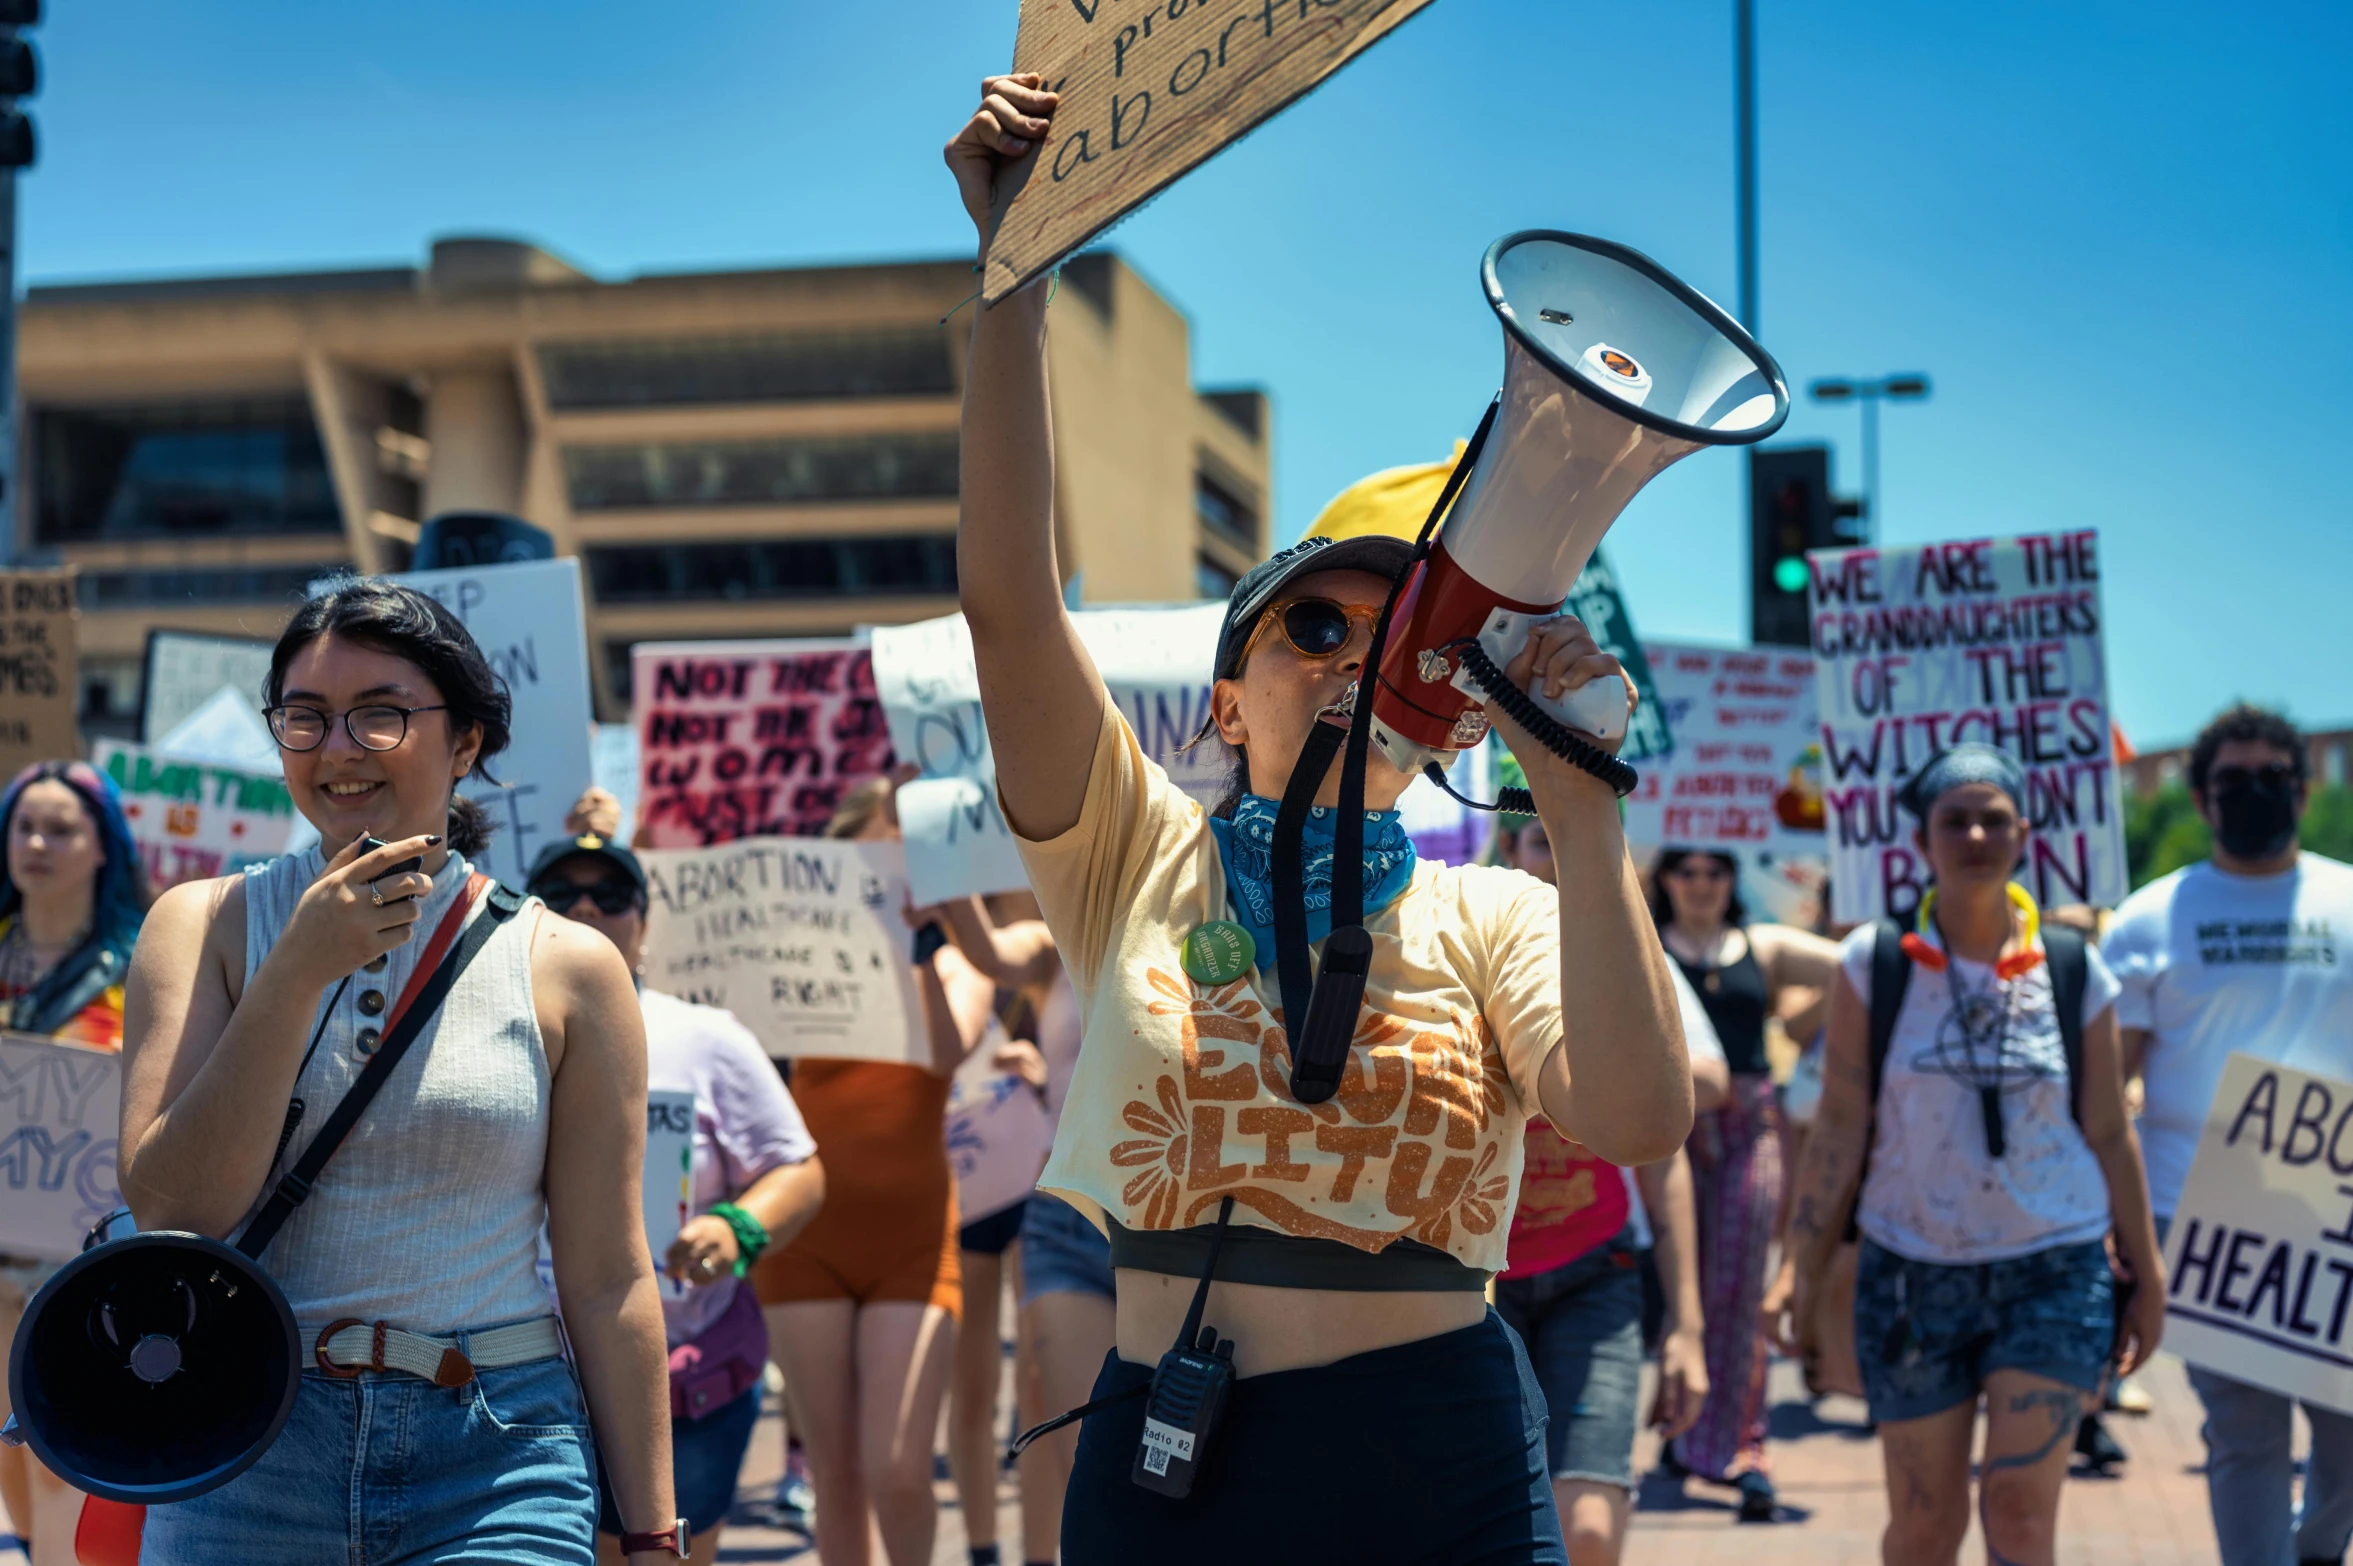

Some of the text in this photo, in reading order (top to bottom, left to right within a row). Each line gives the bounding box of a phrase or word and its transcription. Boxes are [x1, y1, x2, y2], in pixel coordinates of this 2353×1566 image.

[1808, 530, 2099, 605] WE ARE THE
[655, 658, 756, 702] NOT
[1852, 642, 2070, 716] OF THE
[1197, 930, 1221, 979] ORGANIZER
[1213, 924, 1242, 972] BANS OFF
[1144, 1426, 1172, 1446] Radio
